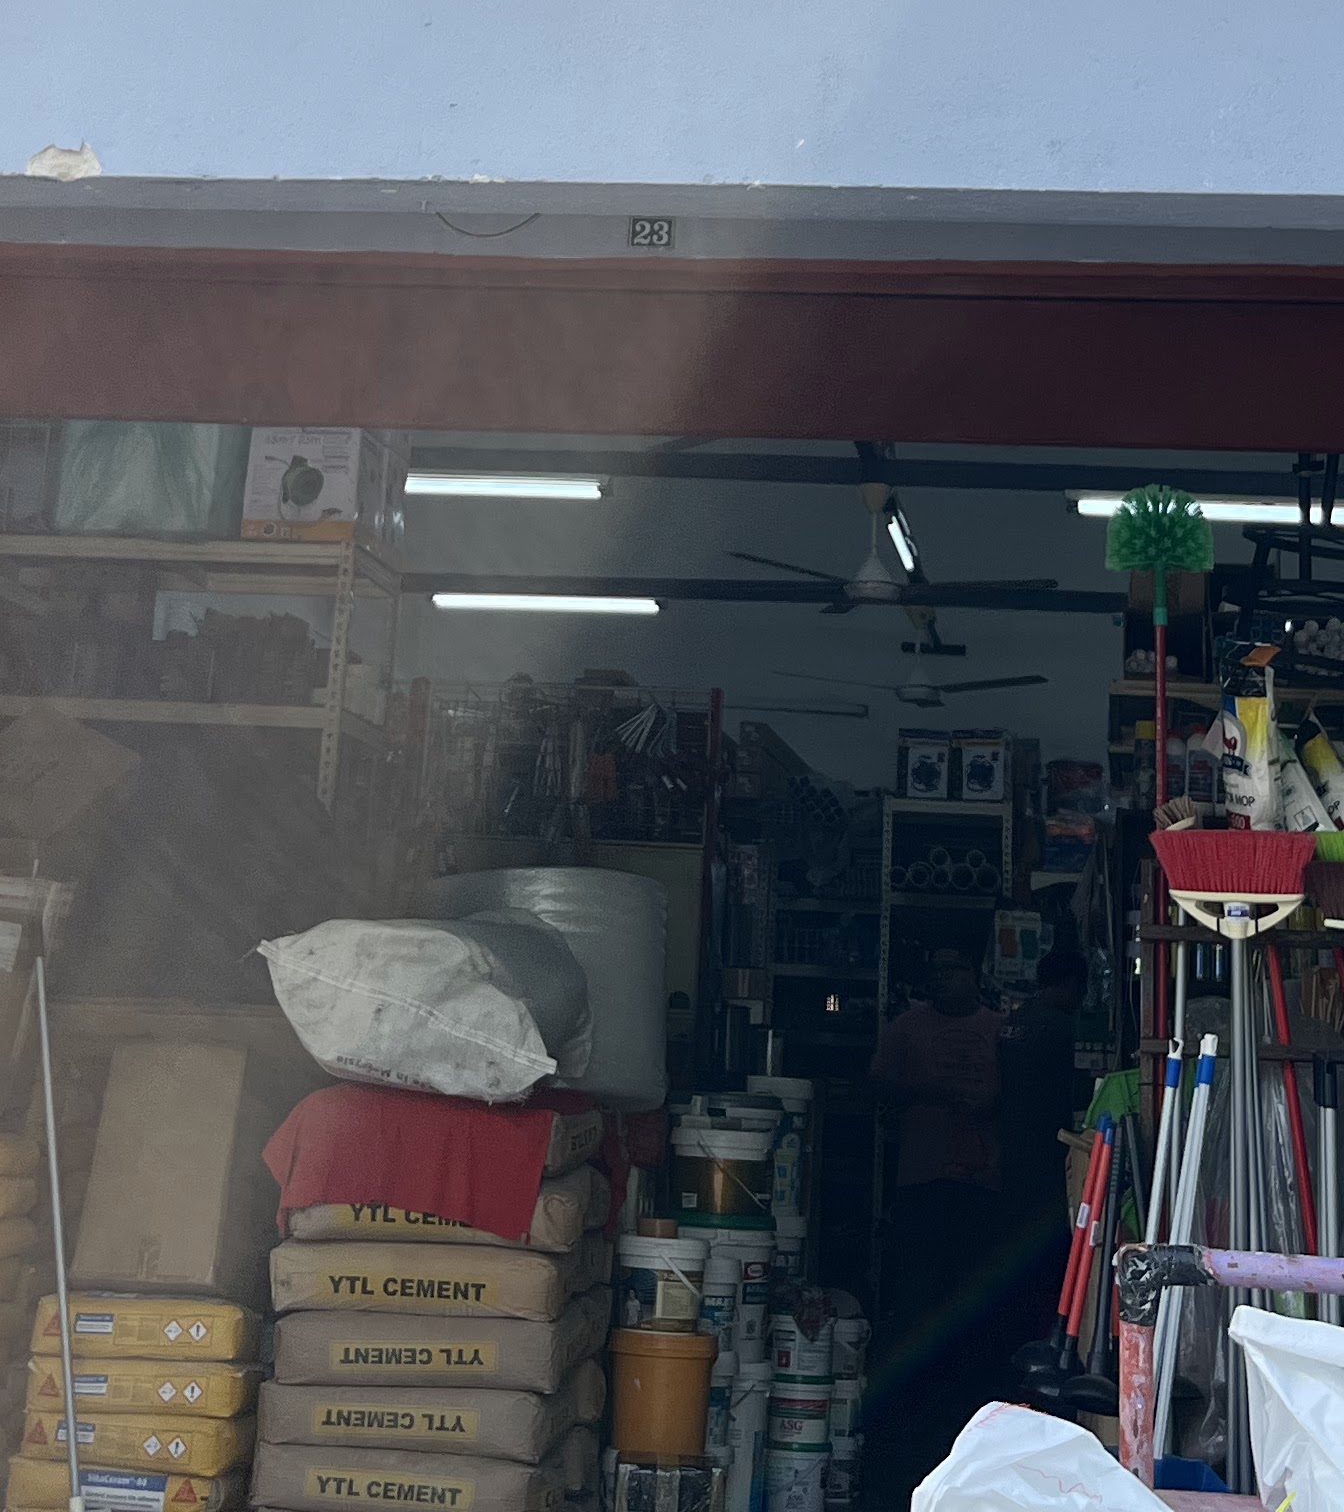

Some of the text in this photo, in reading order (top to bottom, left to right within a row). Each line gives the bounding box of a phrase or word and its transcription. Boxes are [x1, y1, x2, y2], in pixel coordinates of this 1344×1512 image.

[633, 220, 670, 246] 23
[328, 1275, 487, 1302] YTL CEMENT
[339, 1346, 485, 1366] YTL CEMENT
[320, 1407, 467, 1433] YTL CEMENT
[316, 1475, 463, 1507] YTL CEMENT
